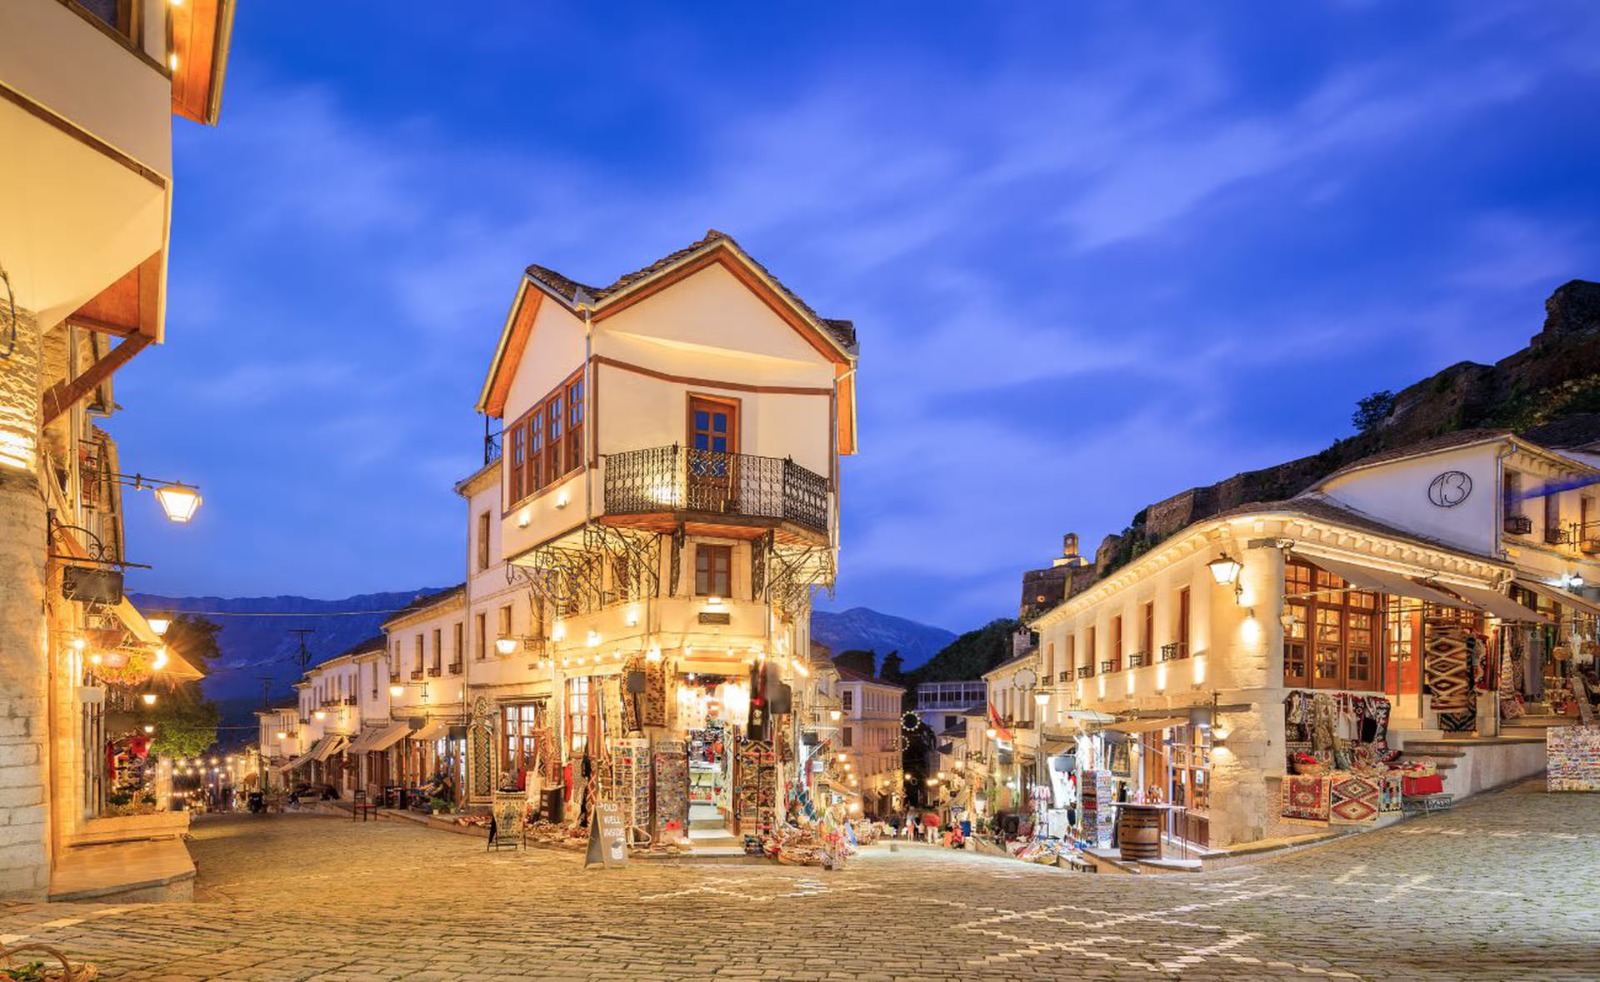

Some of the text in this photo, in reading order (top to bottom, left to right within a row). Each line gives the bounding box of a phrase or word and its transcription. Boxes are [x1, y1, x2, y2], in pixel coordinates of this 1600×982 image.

[1433, 473, 1466, 506] 13
[603, 803, 618, 812] OLD
[603, 815, 621, 825] WELL
[603, 827, 625, 837] INSIDE
